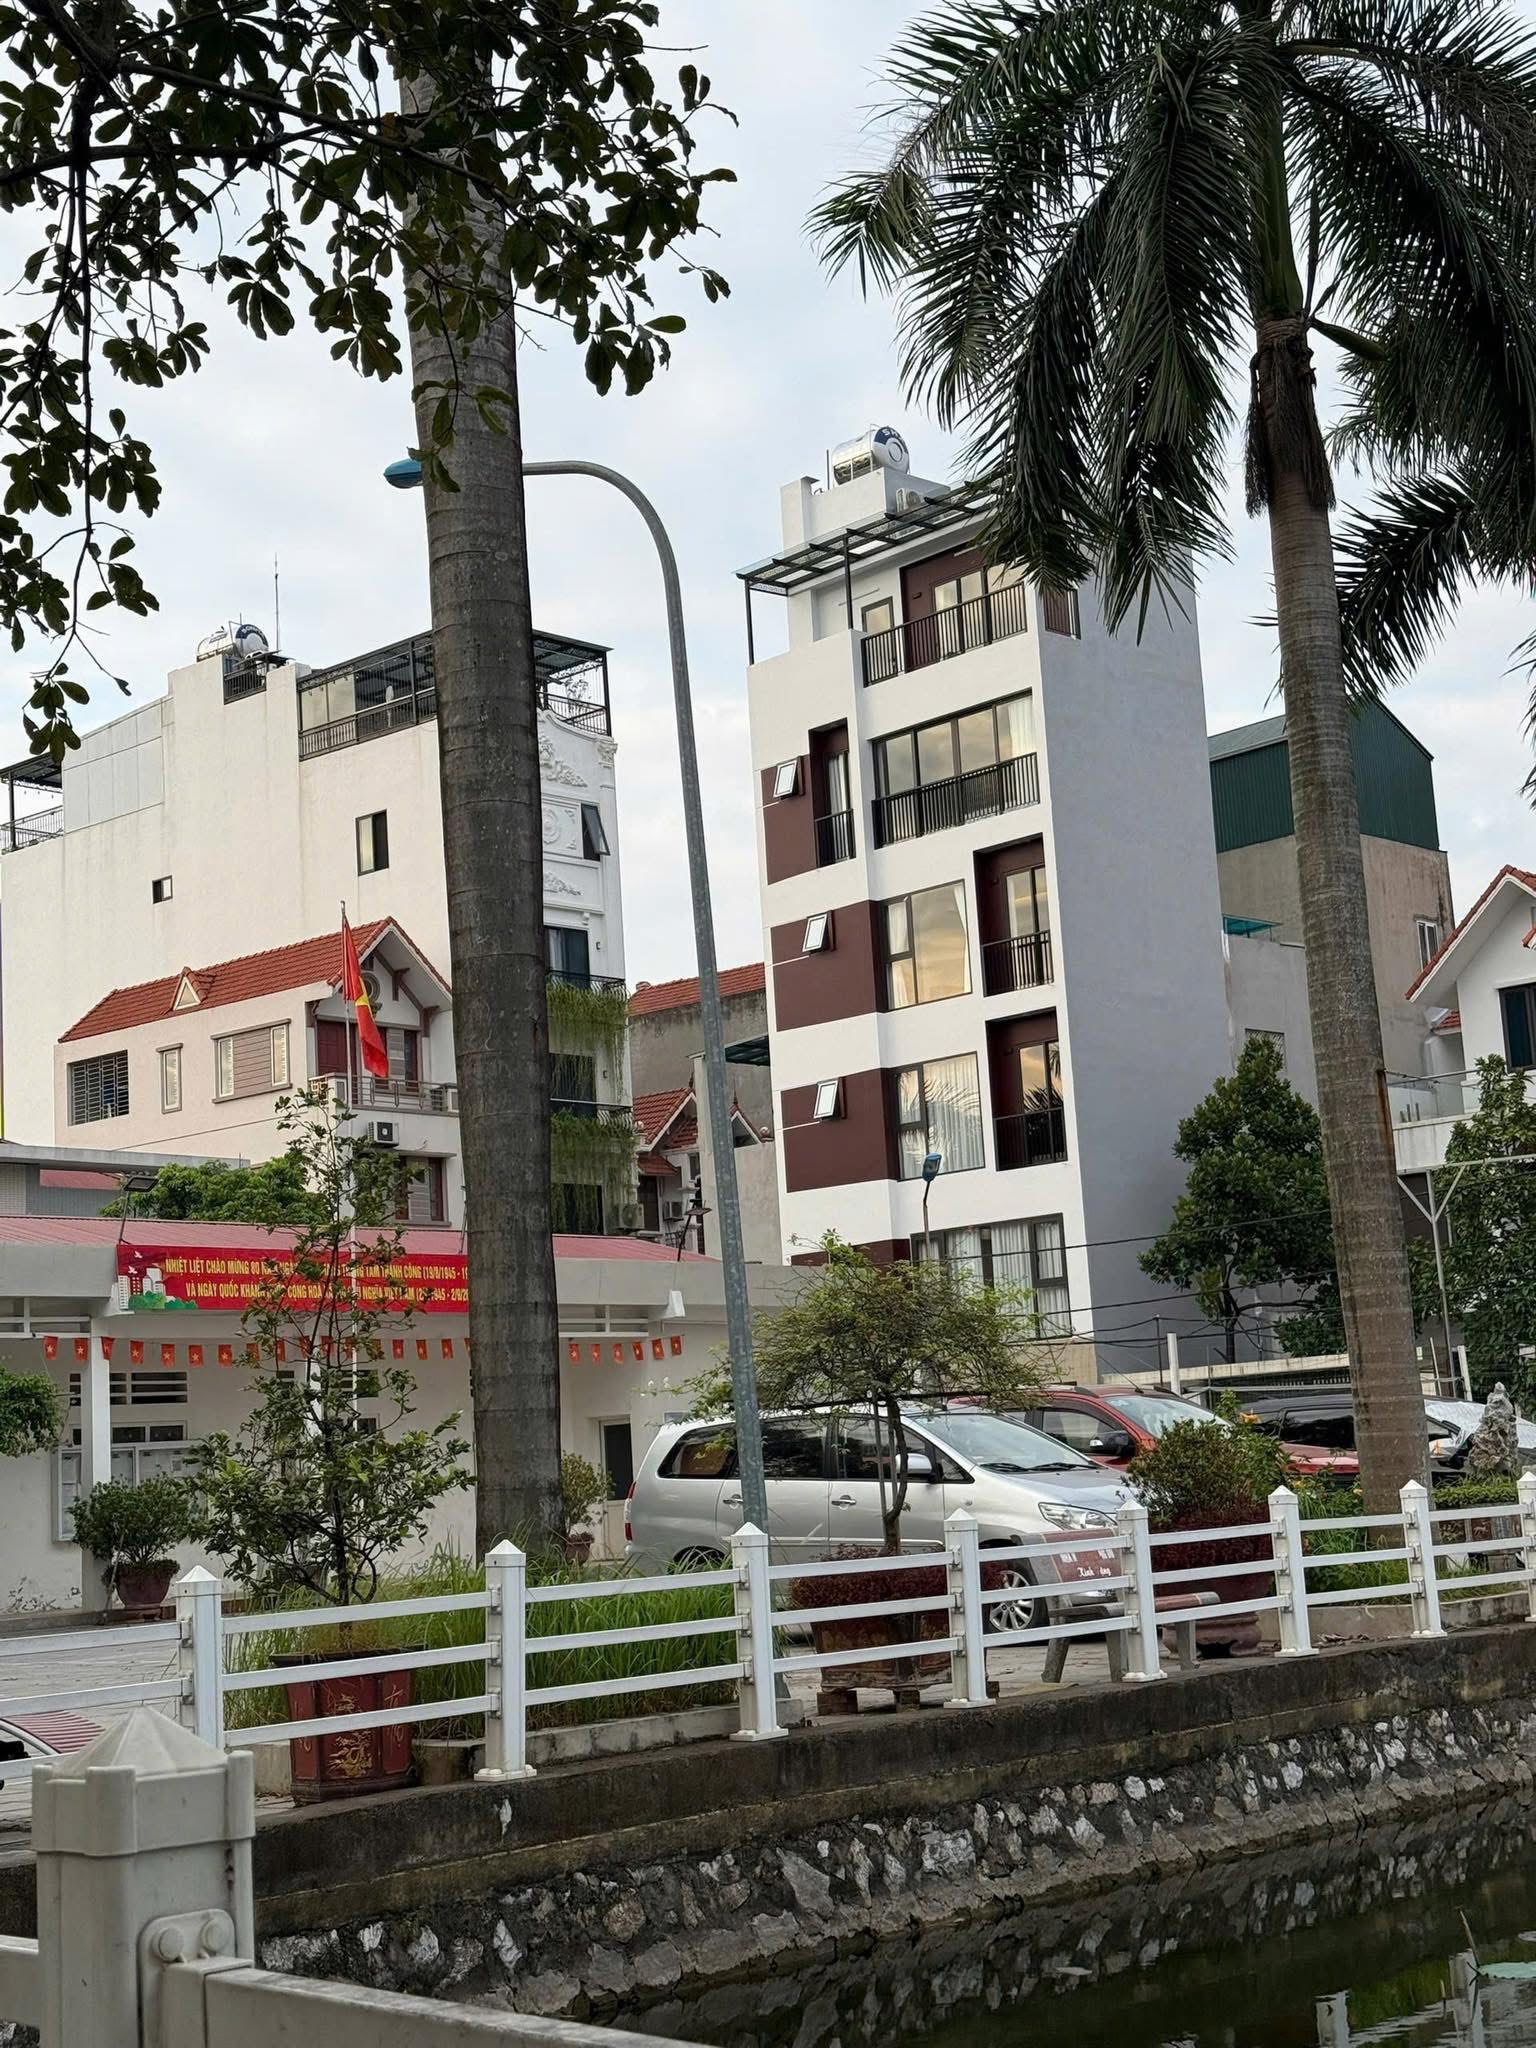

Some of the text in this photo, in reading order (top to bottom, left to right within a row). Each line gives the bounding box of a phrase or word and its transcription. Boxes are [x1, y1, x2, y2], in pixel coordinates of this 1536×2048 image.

[165, 1256, 187, 1276] NHIỆT
[189, 1256, 205, 1277] LIỆT
[206, 1257, 226, 1274] CHÀO
